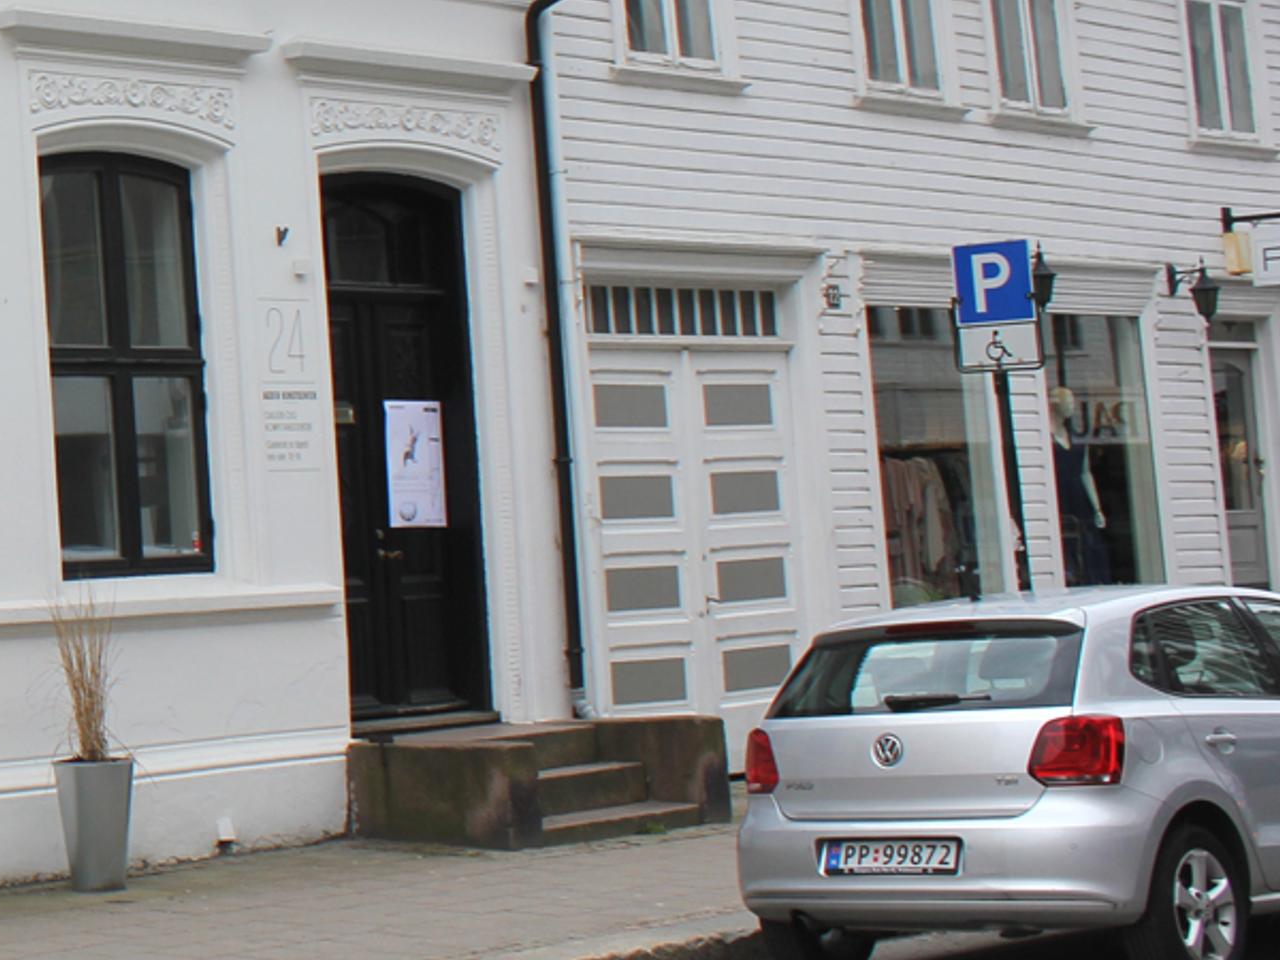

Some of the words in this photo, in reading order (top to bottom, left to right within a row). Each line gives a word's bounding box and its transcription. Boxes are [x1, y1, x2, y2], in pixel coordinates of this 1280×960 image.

[970, 253, 1011, 313] P
[266, 307, 305, 374] 24
[881, 841, 951, 866] 99872
